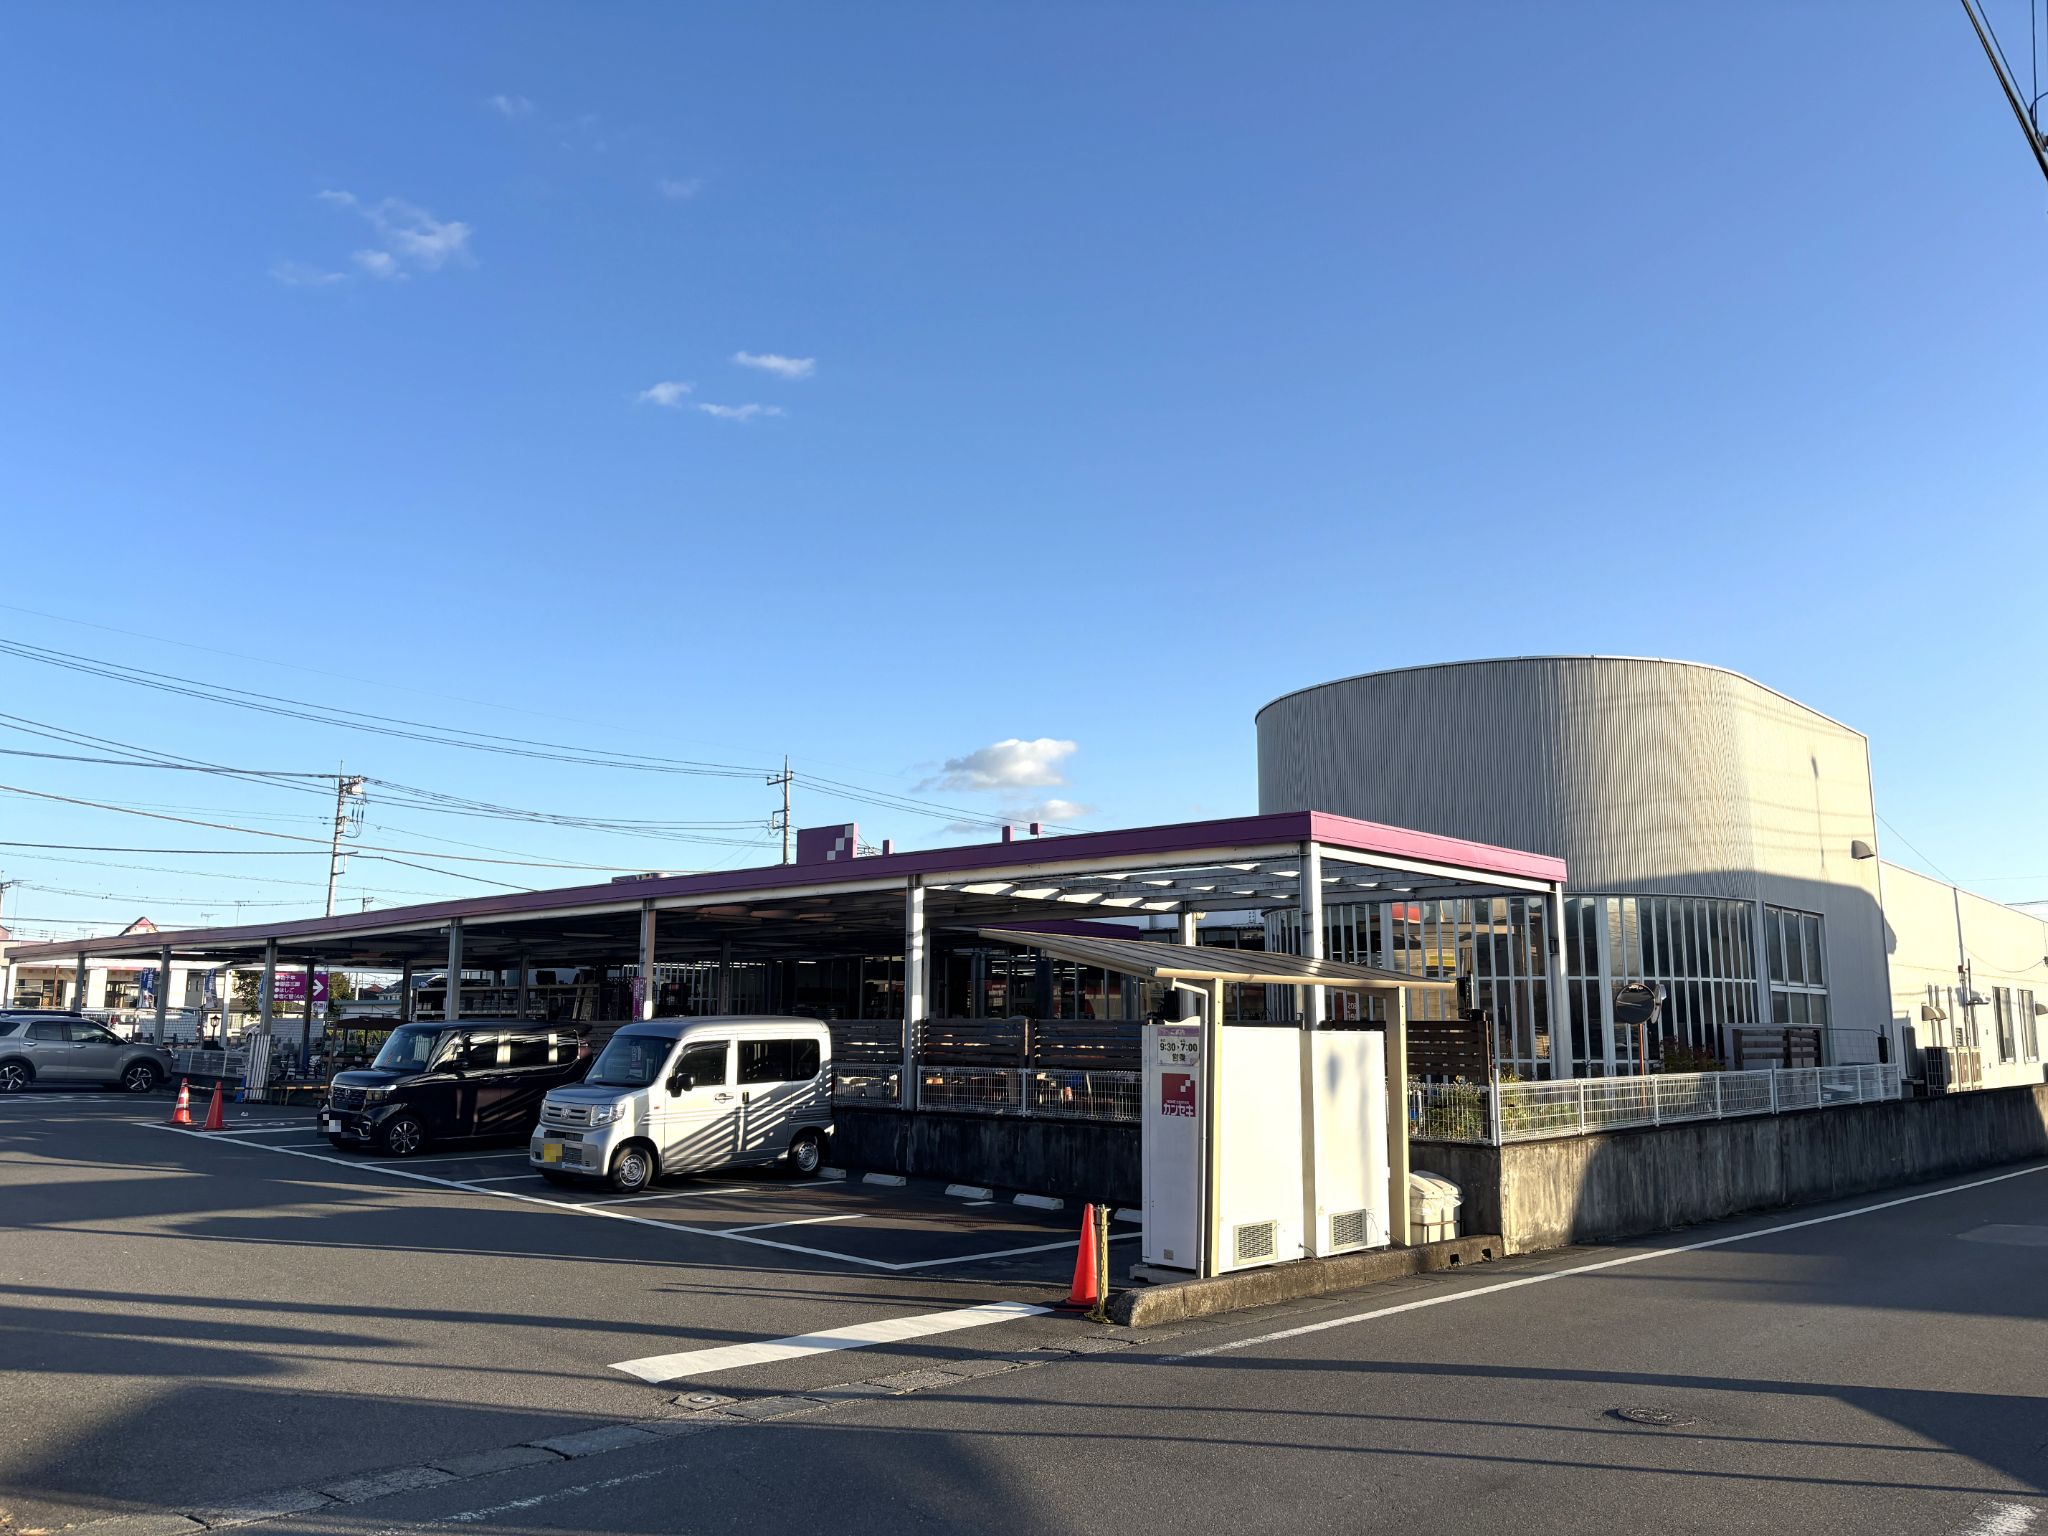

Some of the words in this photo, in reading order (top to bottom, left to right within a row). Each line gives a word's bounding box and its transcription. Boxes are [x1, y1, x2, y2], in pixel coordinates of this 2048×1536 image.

[1160, 1043, 1176, 1051] 9:30
[1180, 1043, 1198, 1052] 7:00
[1172, 1053, 1186, 1062] 営業
[1163, 1103, 1195, 1117] カンセキ
